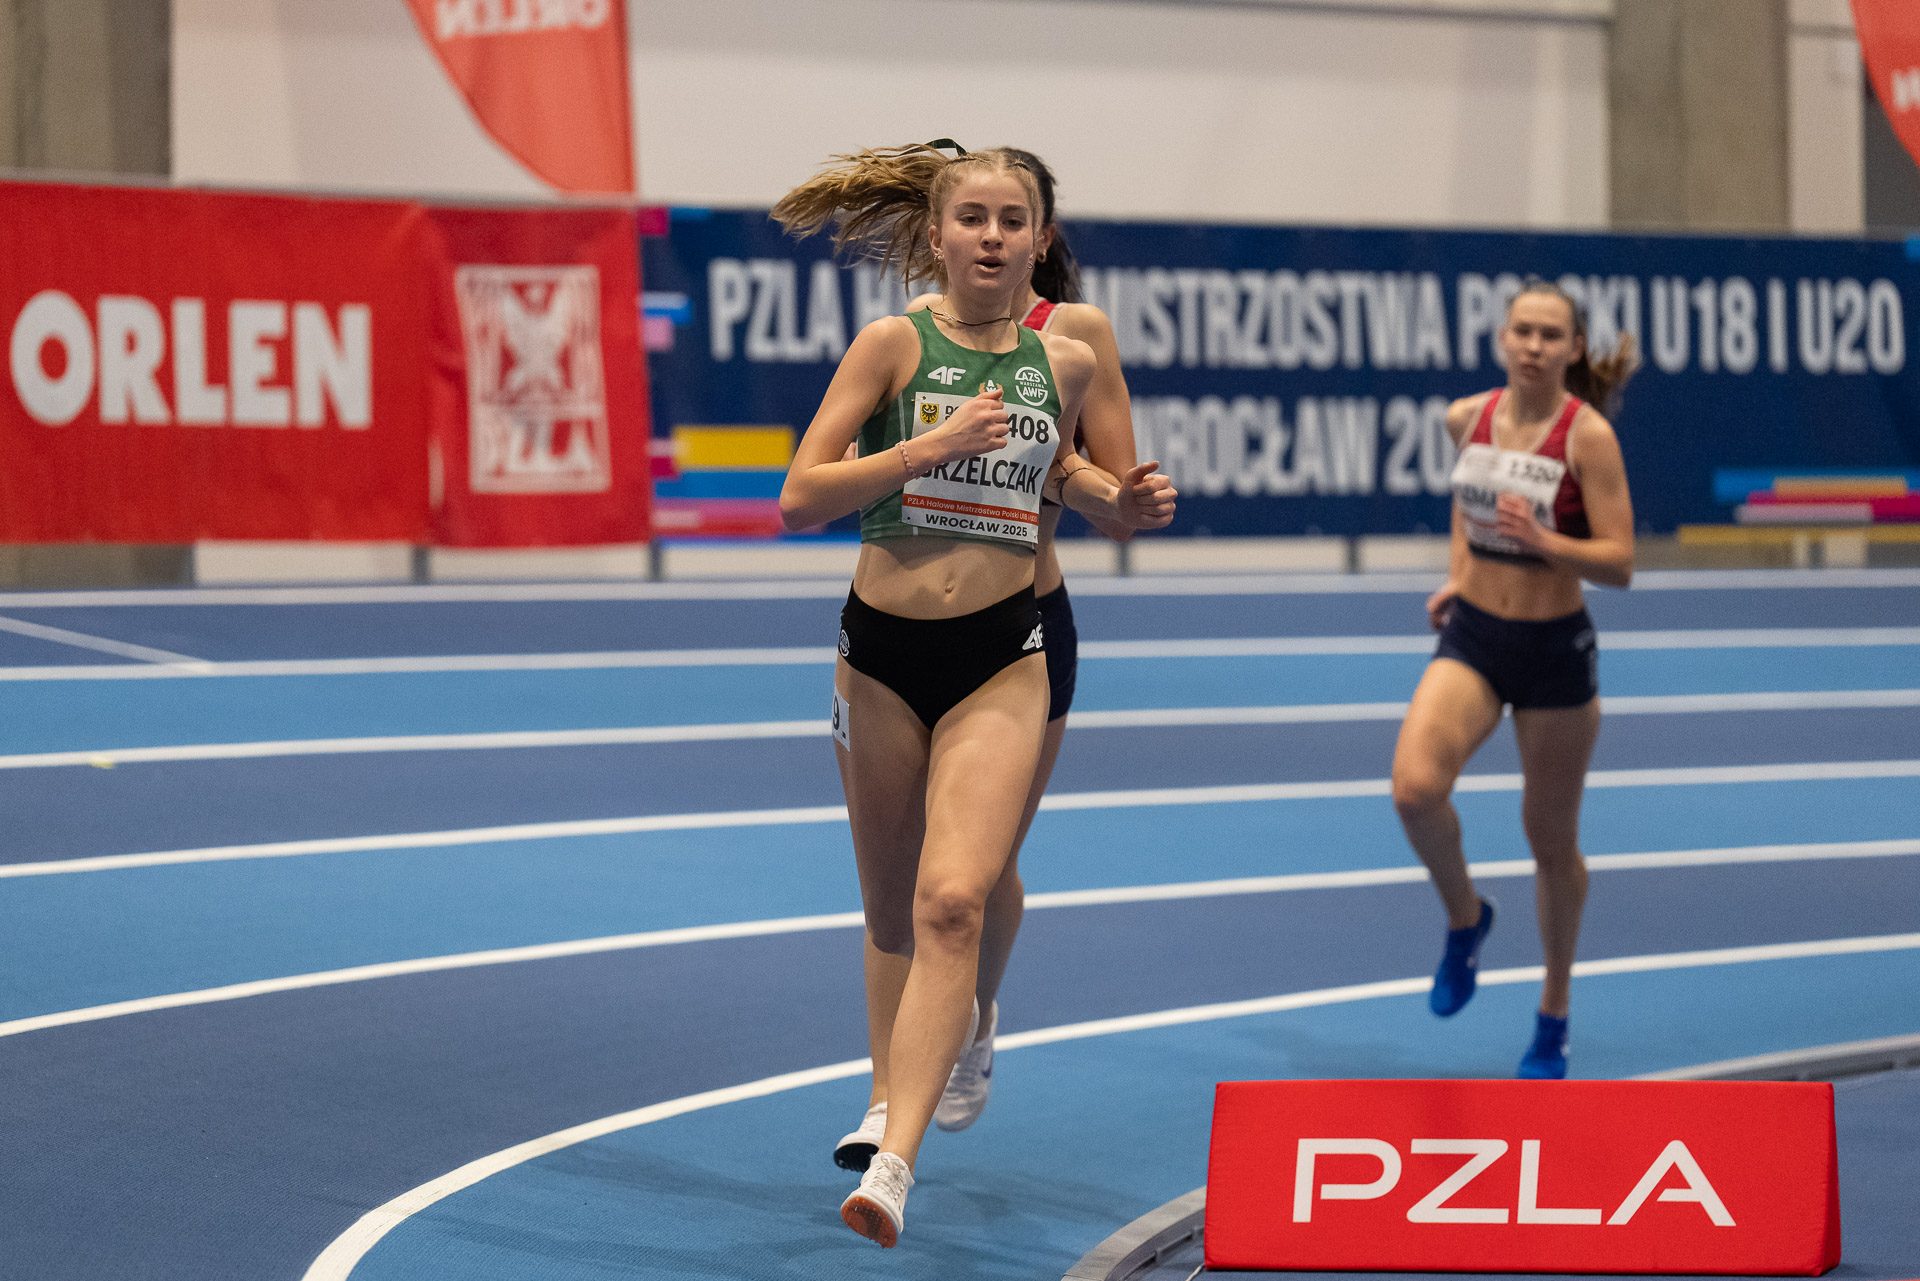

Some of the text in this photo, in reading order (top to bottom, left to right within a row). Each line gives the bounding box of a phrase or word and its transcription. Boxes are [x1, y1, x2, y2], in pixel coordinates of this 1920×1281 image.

[707, 257, 847, 362] PZLA
[1651, 276, 1758, 373] U18
[1799, 278, 1904, 375] U20
[10, 289, 373, 430] ORLEN
[928, 365, 966, 385] 4F
[1022, 371, 1041, 383] AZS
[1023, 386, 1044, 399] AWF
[1384, 396, 1457, 497] 20
[907, 497, 925, 506] PZLA
[926, 500, 955, 510] Halowe
[956, 504, 1000, 517] Mistrzostwa
[1001, 510, 1020, 519] Polski
[925, 514, 1028, 537] WROCŁAW 2025
[832, 695, 840, 730] 9
[1292, 1137, 1737, 1226] PZLA
